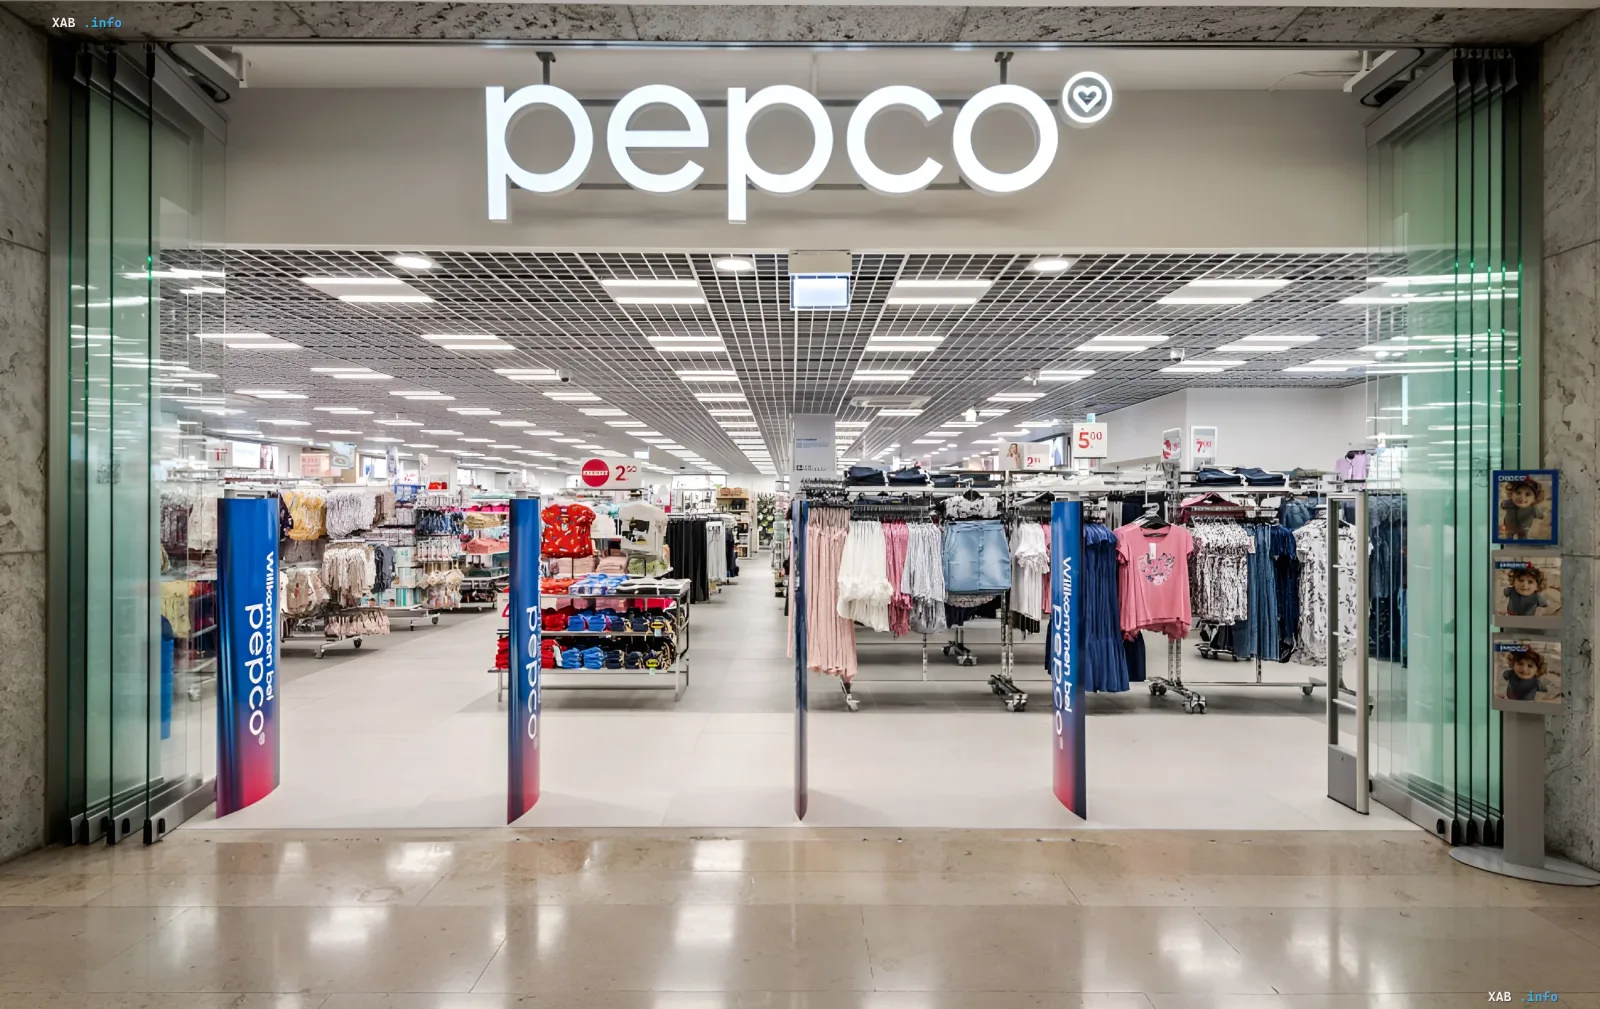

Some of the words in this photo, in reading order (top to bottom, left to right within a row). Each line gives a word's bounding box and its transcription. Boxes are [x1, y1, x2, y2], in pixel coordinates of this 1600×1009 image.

[485, 84, 1059, 223] pepco
[245, 603, 264, 736] pepco
[526, 606, 537, 739] pepco
[1053, 603, 1063, 736] pepco
